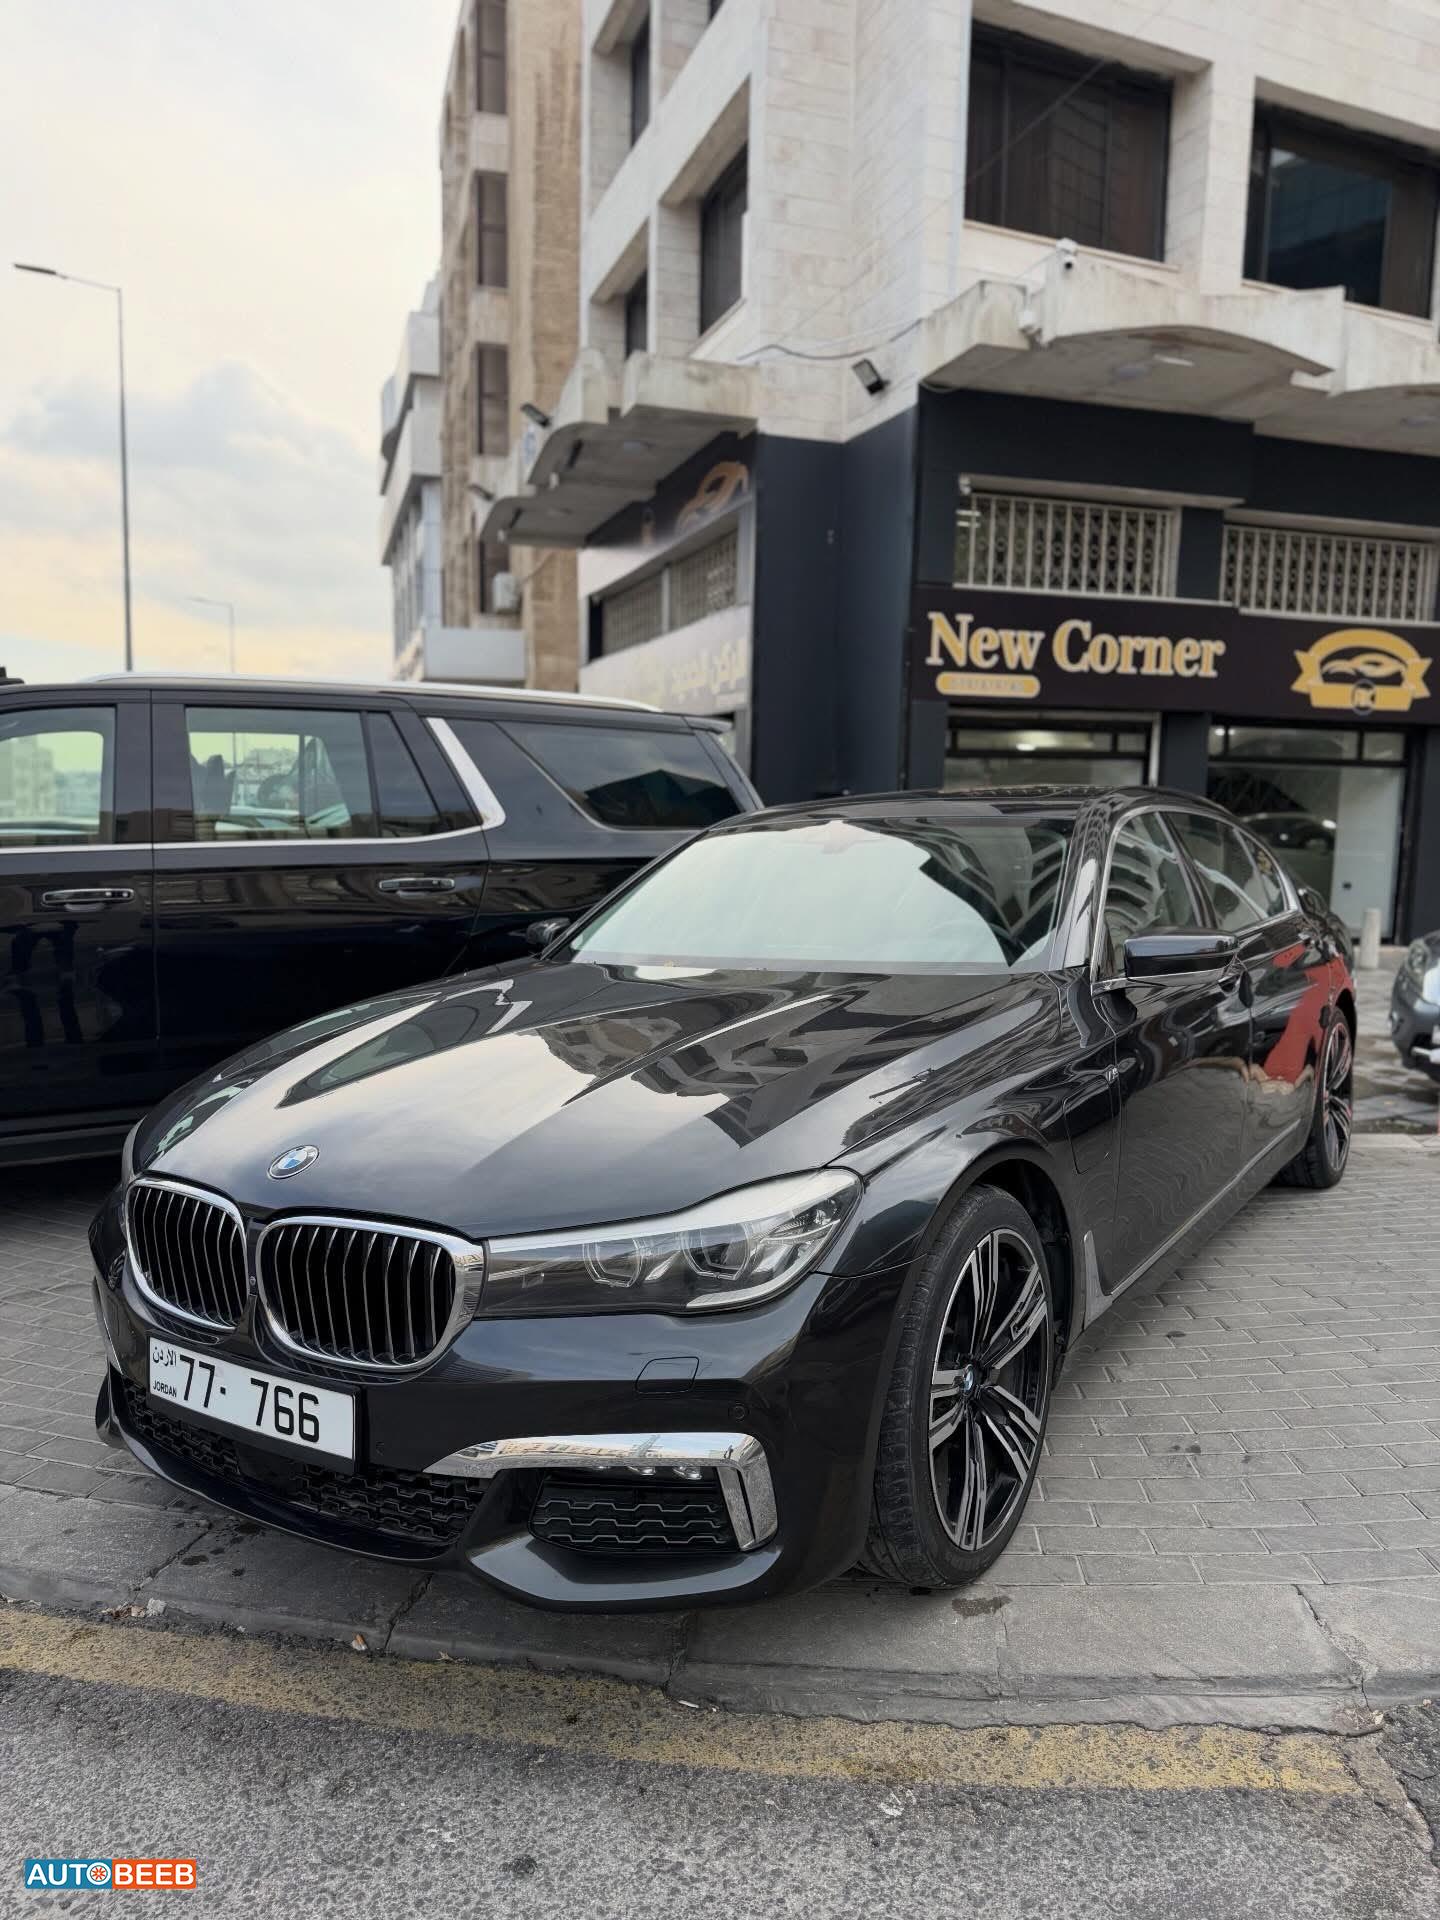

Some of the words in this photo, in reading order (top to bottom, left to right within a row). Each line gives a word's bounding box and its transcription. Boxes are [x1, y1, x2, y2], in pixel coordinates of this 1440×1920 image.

[927, 611, 1044, 671] New
[1051, 619, 1226, 679] Corner
[152, 1379, 177, 1398] JORDAN
[250, 1377, 320, 1443] 766
